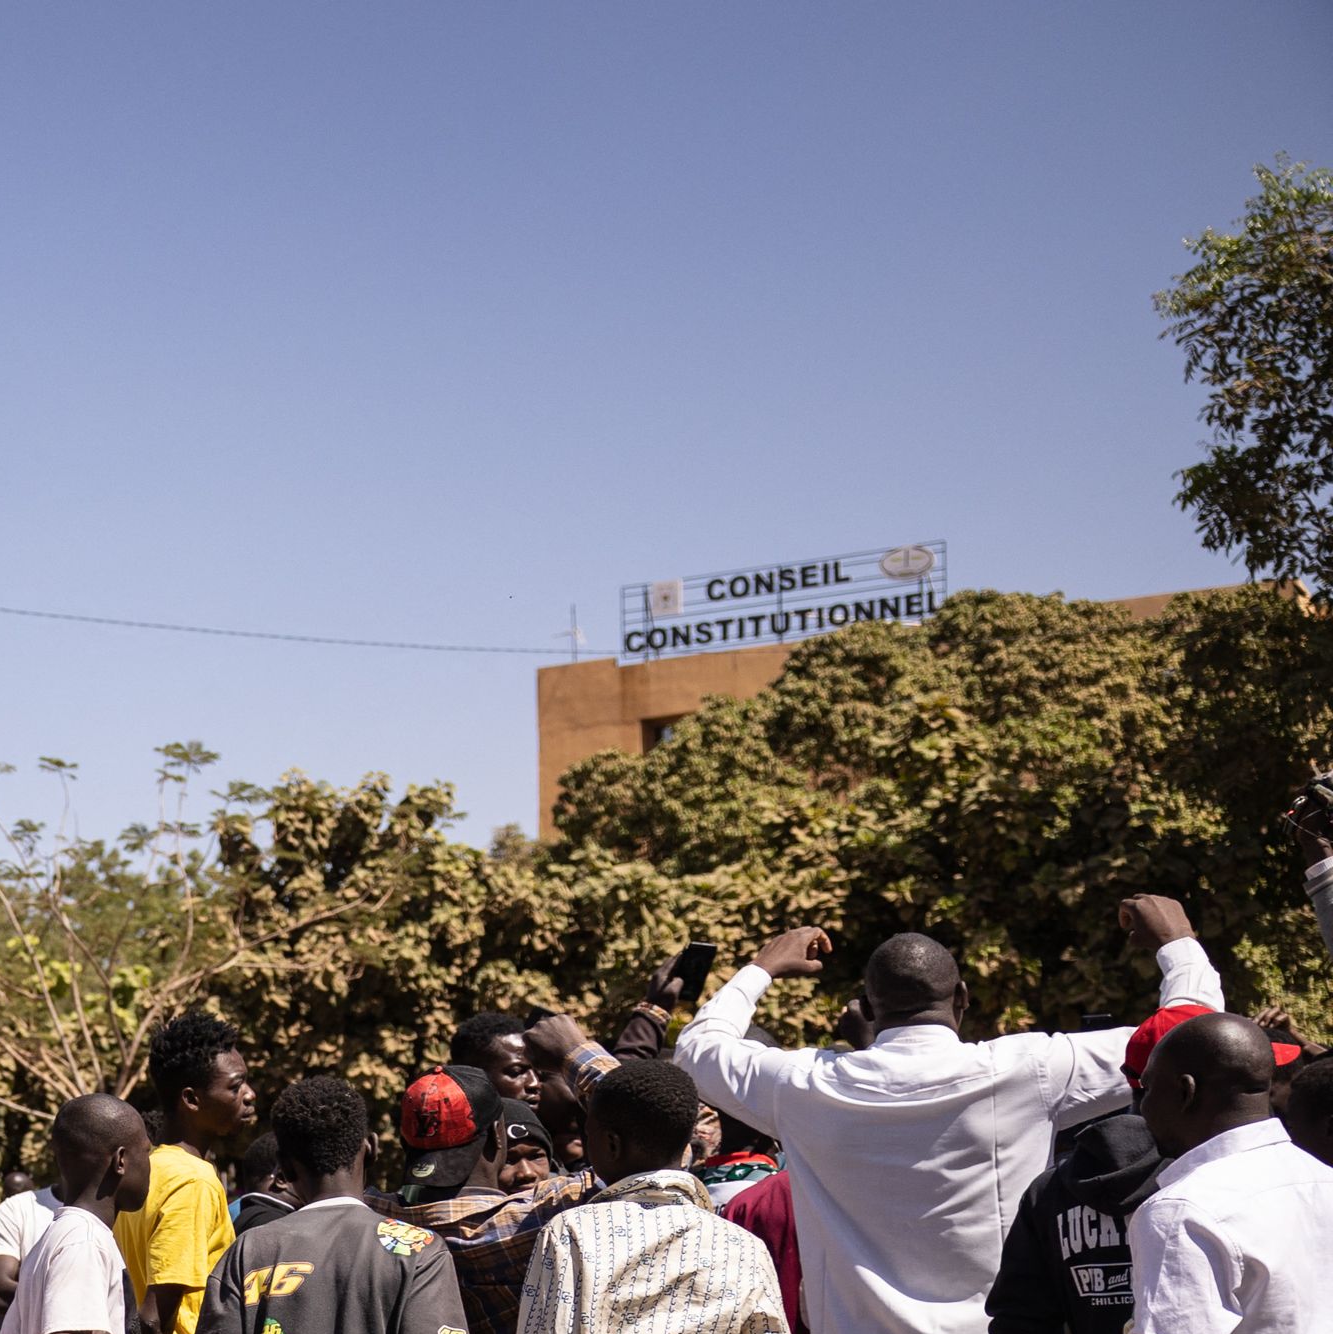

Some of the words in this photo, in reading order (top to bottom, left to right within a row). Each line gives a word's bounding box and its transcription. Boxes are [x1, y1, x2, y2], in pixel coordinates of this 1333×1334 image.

[707, 560, 851, 601] CONSEIL
[625, 591, 939, 653] CONSTITUTIONNEL
[244, 1262, 314, 1306] 46
